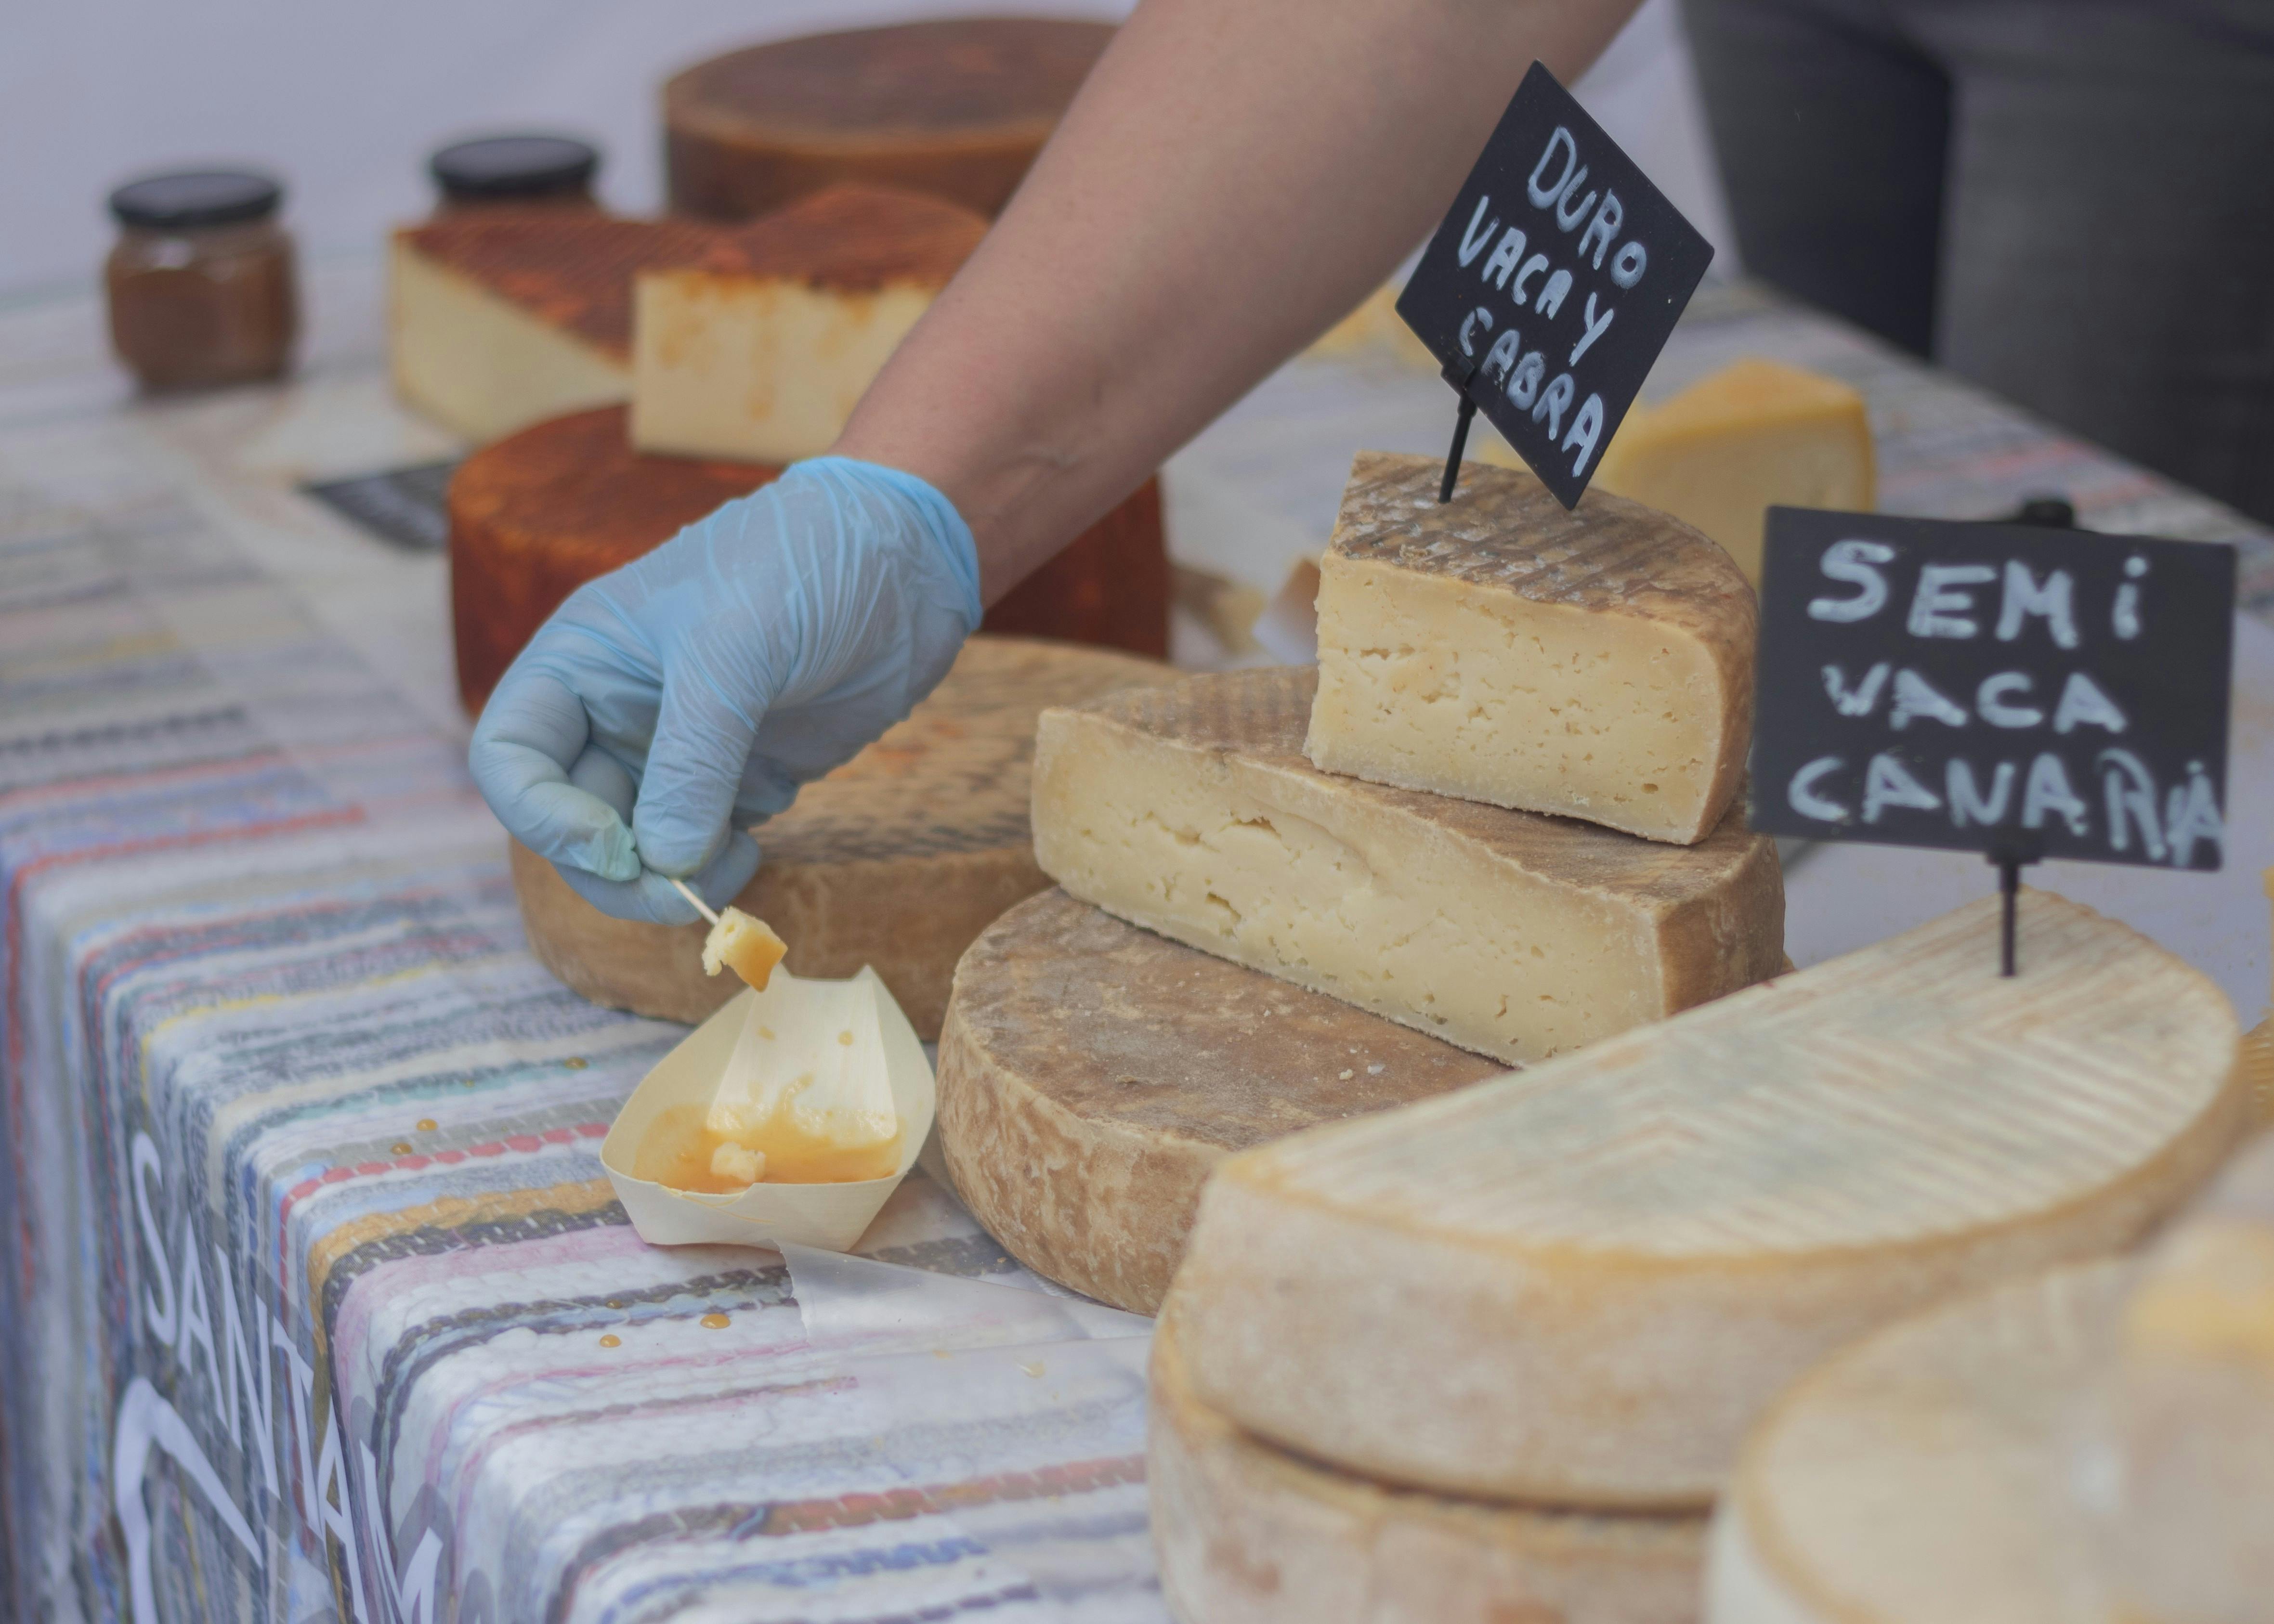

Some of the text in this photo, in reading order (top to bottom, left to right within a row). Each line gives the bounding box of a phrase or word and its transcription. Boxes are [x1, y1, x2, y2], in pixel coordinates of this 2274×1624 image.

[1458, 195, 1615, 367] VACA Y
[1528, 125, 1647, 289] DURO
[1459, 306, 1604, 478] CABRA
[1821, 662, 2128, 734] VACA
